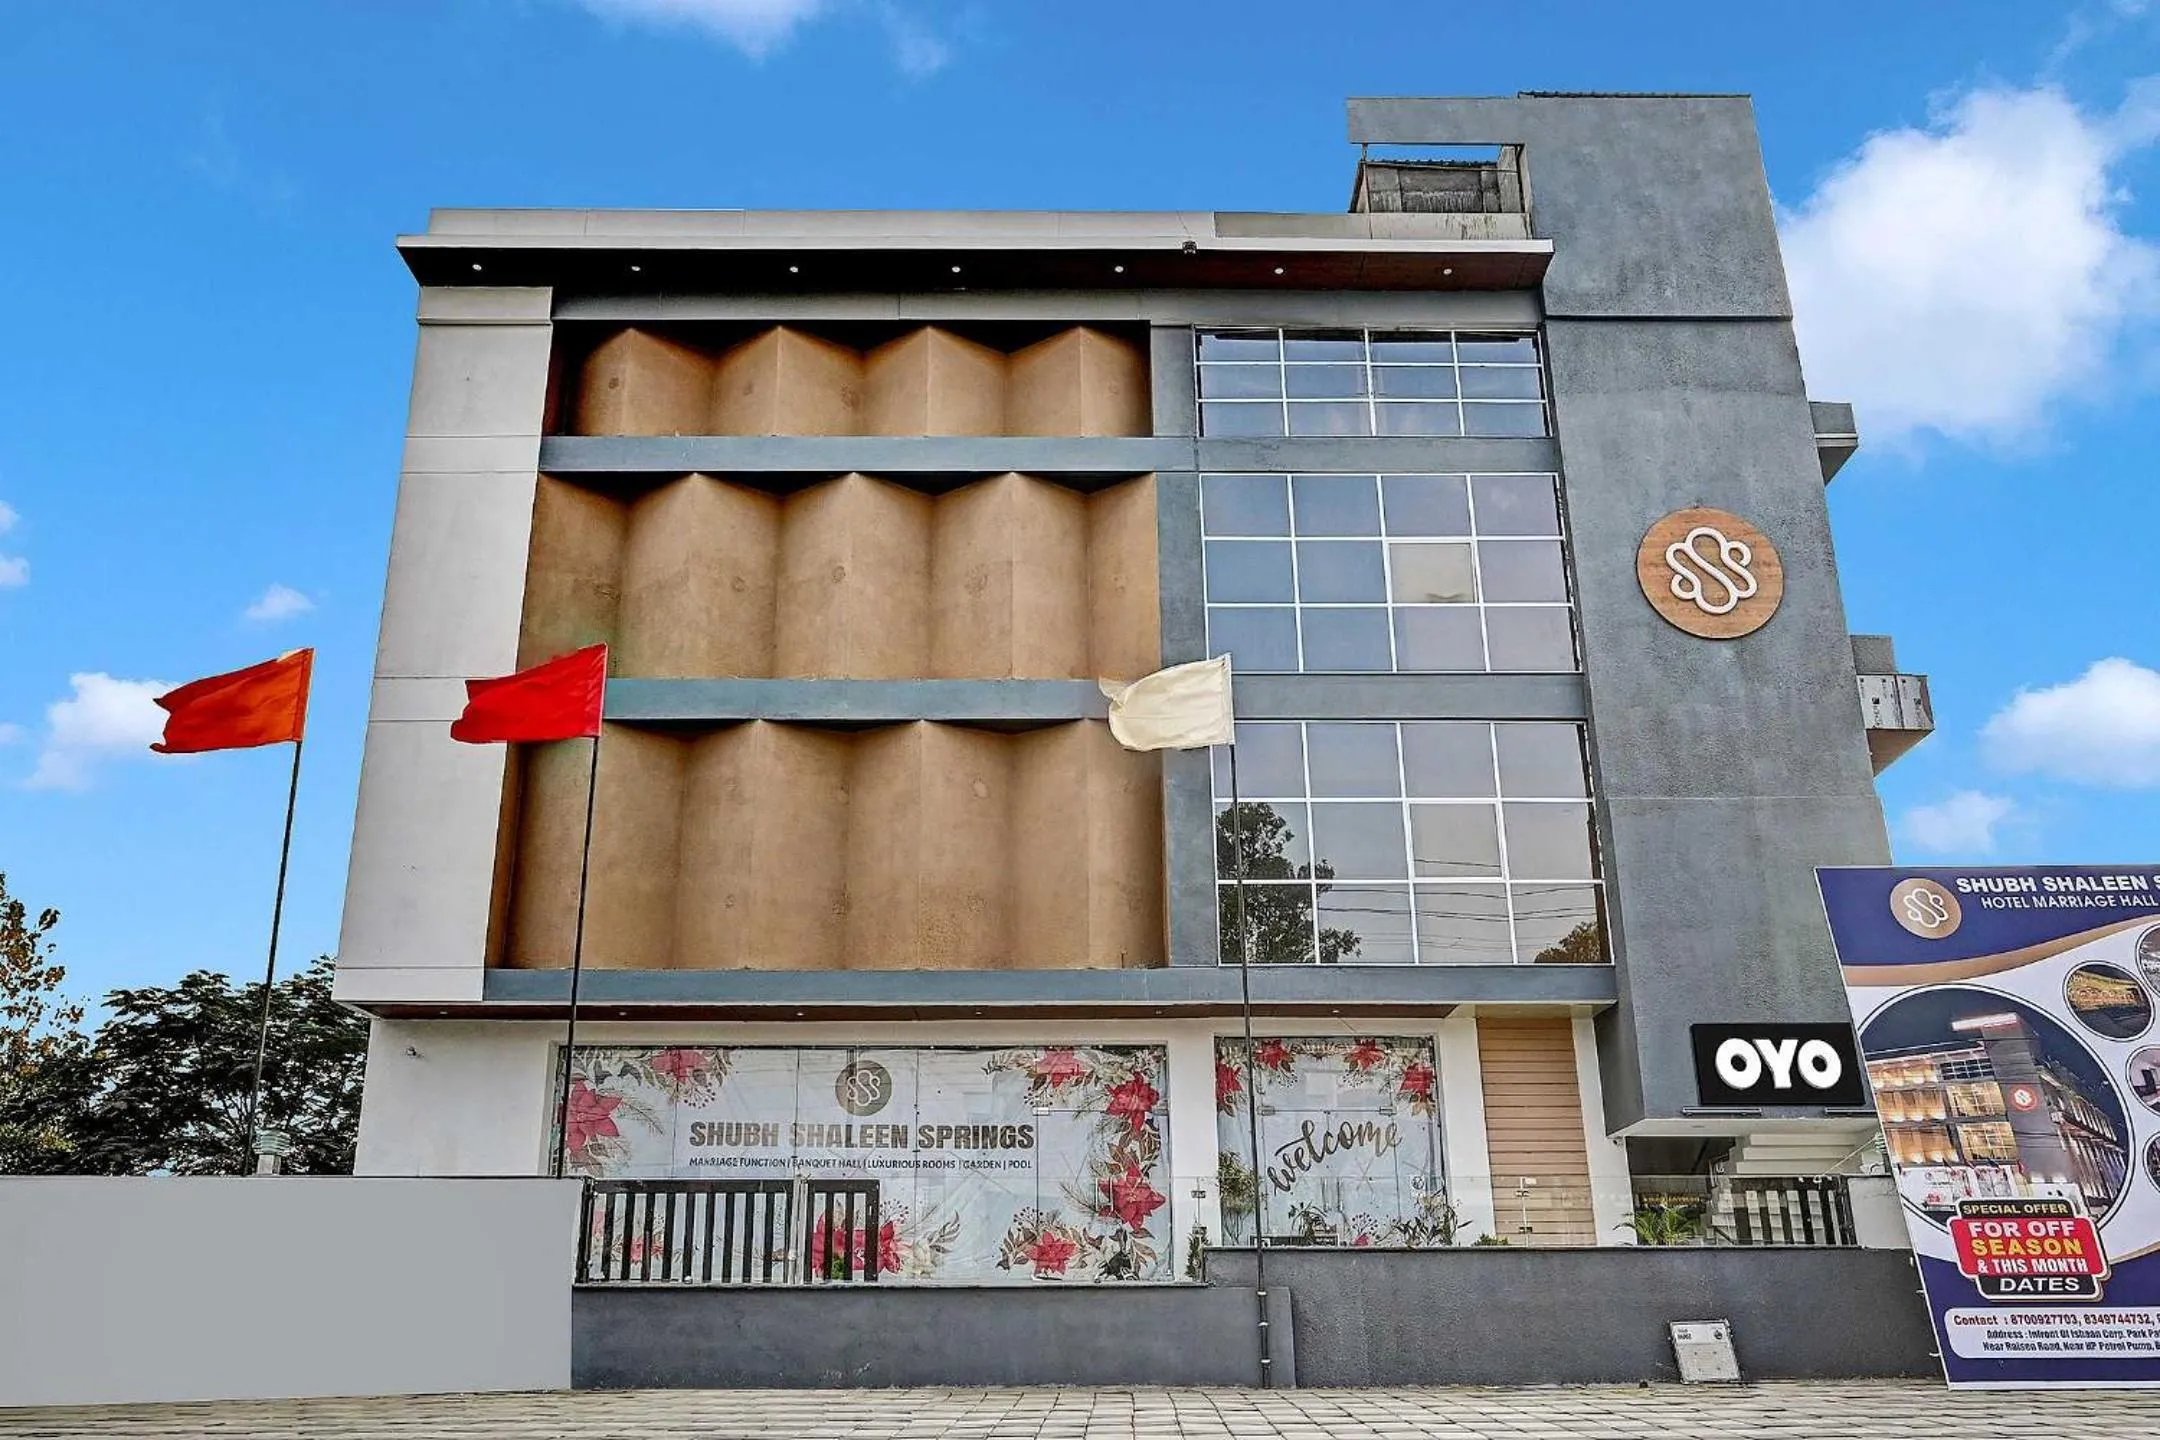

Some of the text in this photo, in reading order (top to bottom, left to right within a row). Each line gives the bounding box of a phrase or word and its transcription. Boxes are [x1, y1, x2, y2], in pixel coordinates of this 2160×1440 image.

[1956, 877, 2037, 893] SHUBH
[2042, 875, 2149, 892] SHALEEN
[1980, 894, 2159, 909] HOTEL MARRIAGE HALL
[1714, 1037, 1843, 1091] OYO
[689, 1121, 1035, 1150] SHUBH SHALEEN SPRINGS
[689, 1157, 1032, 1169] MARRIAGE FUNCTION BANQUET HALL LUXURIOUS ROOMS GARDEN POOL
[1266, 1118, 1404, 1198] welcome
[1962, 1203, 2069, 1215] SPECIAL OFFER
[1968, 1221, 2075, 1238] FOR OFF
[1971, 1238, 2083, 1256] SEASON
[1977, 1258, 2089, 1273] & THIS MONTH
[1999, 1278, 2080, 1291] DATES
[1953, 1315, 1998, 1326] Contact
